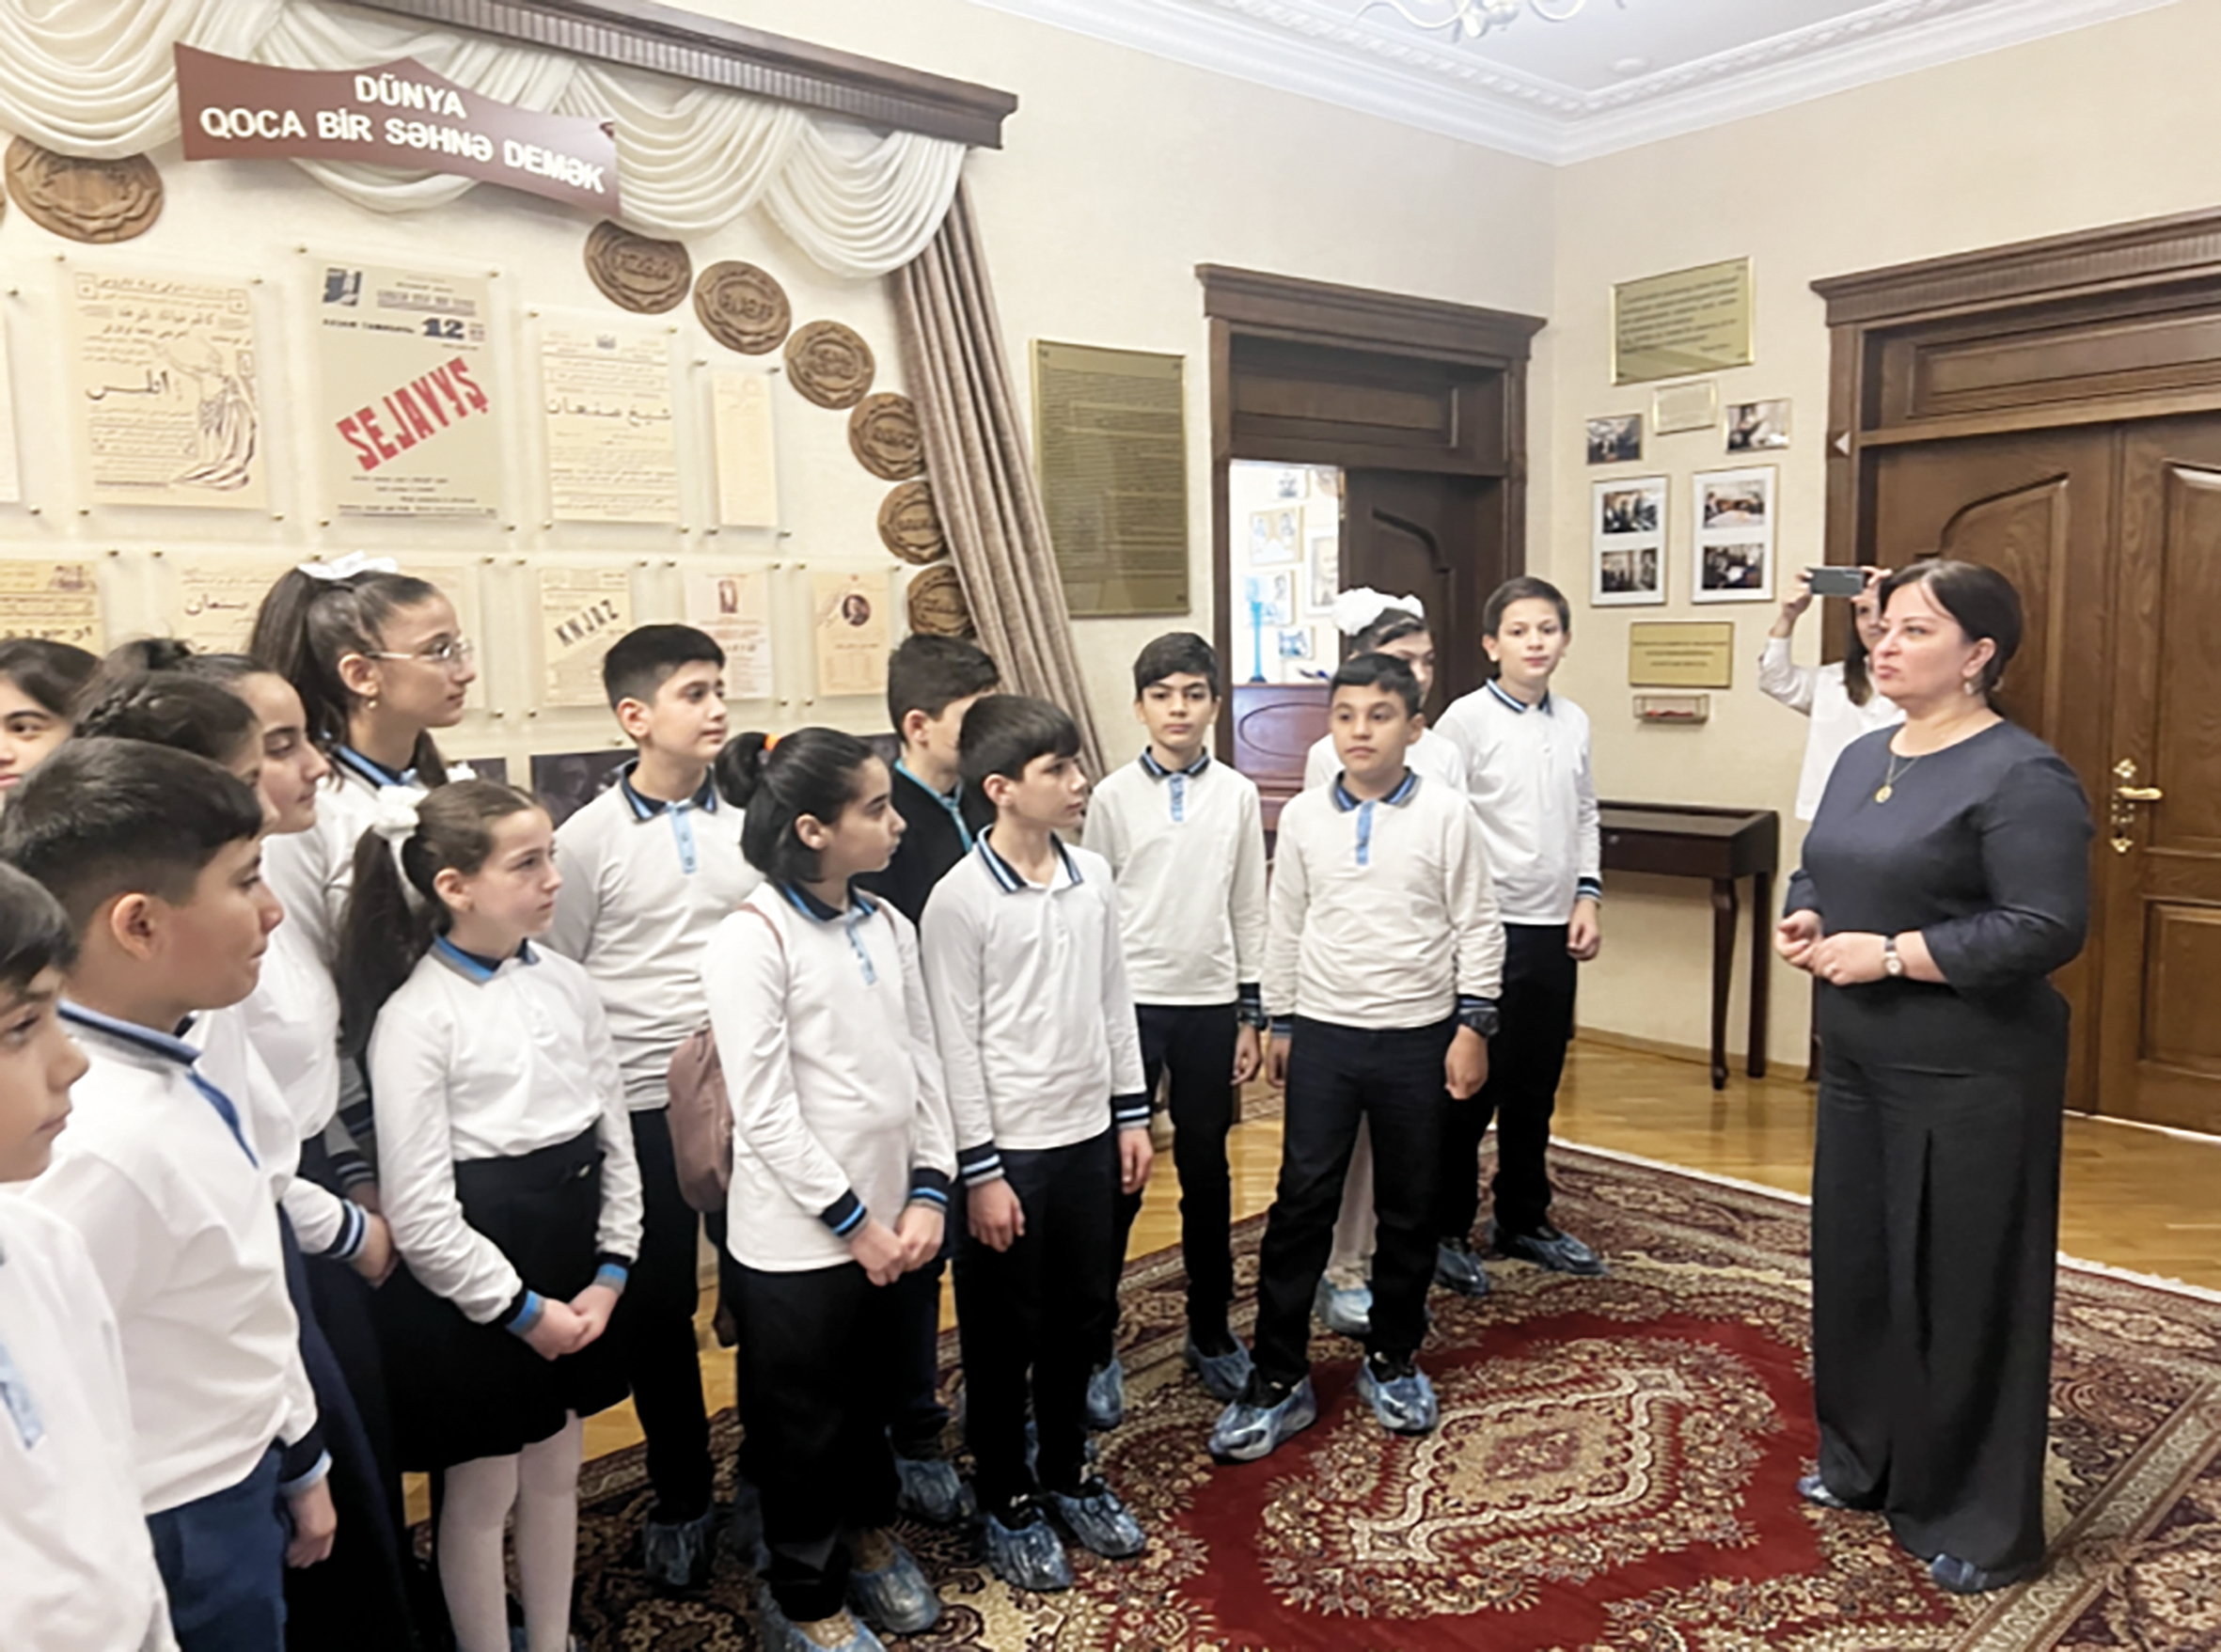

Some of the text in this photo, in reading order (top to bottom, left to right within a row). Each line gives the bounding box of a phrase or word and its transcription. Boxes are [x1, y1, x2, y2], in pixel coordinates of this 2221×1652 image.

[199, 107, 605, 194] QOCA BİR SƏHNƏ DEMƏK
[422, 318, 465, 339] 12
